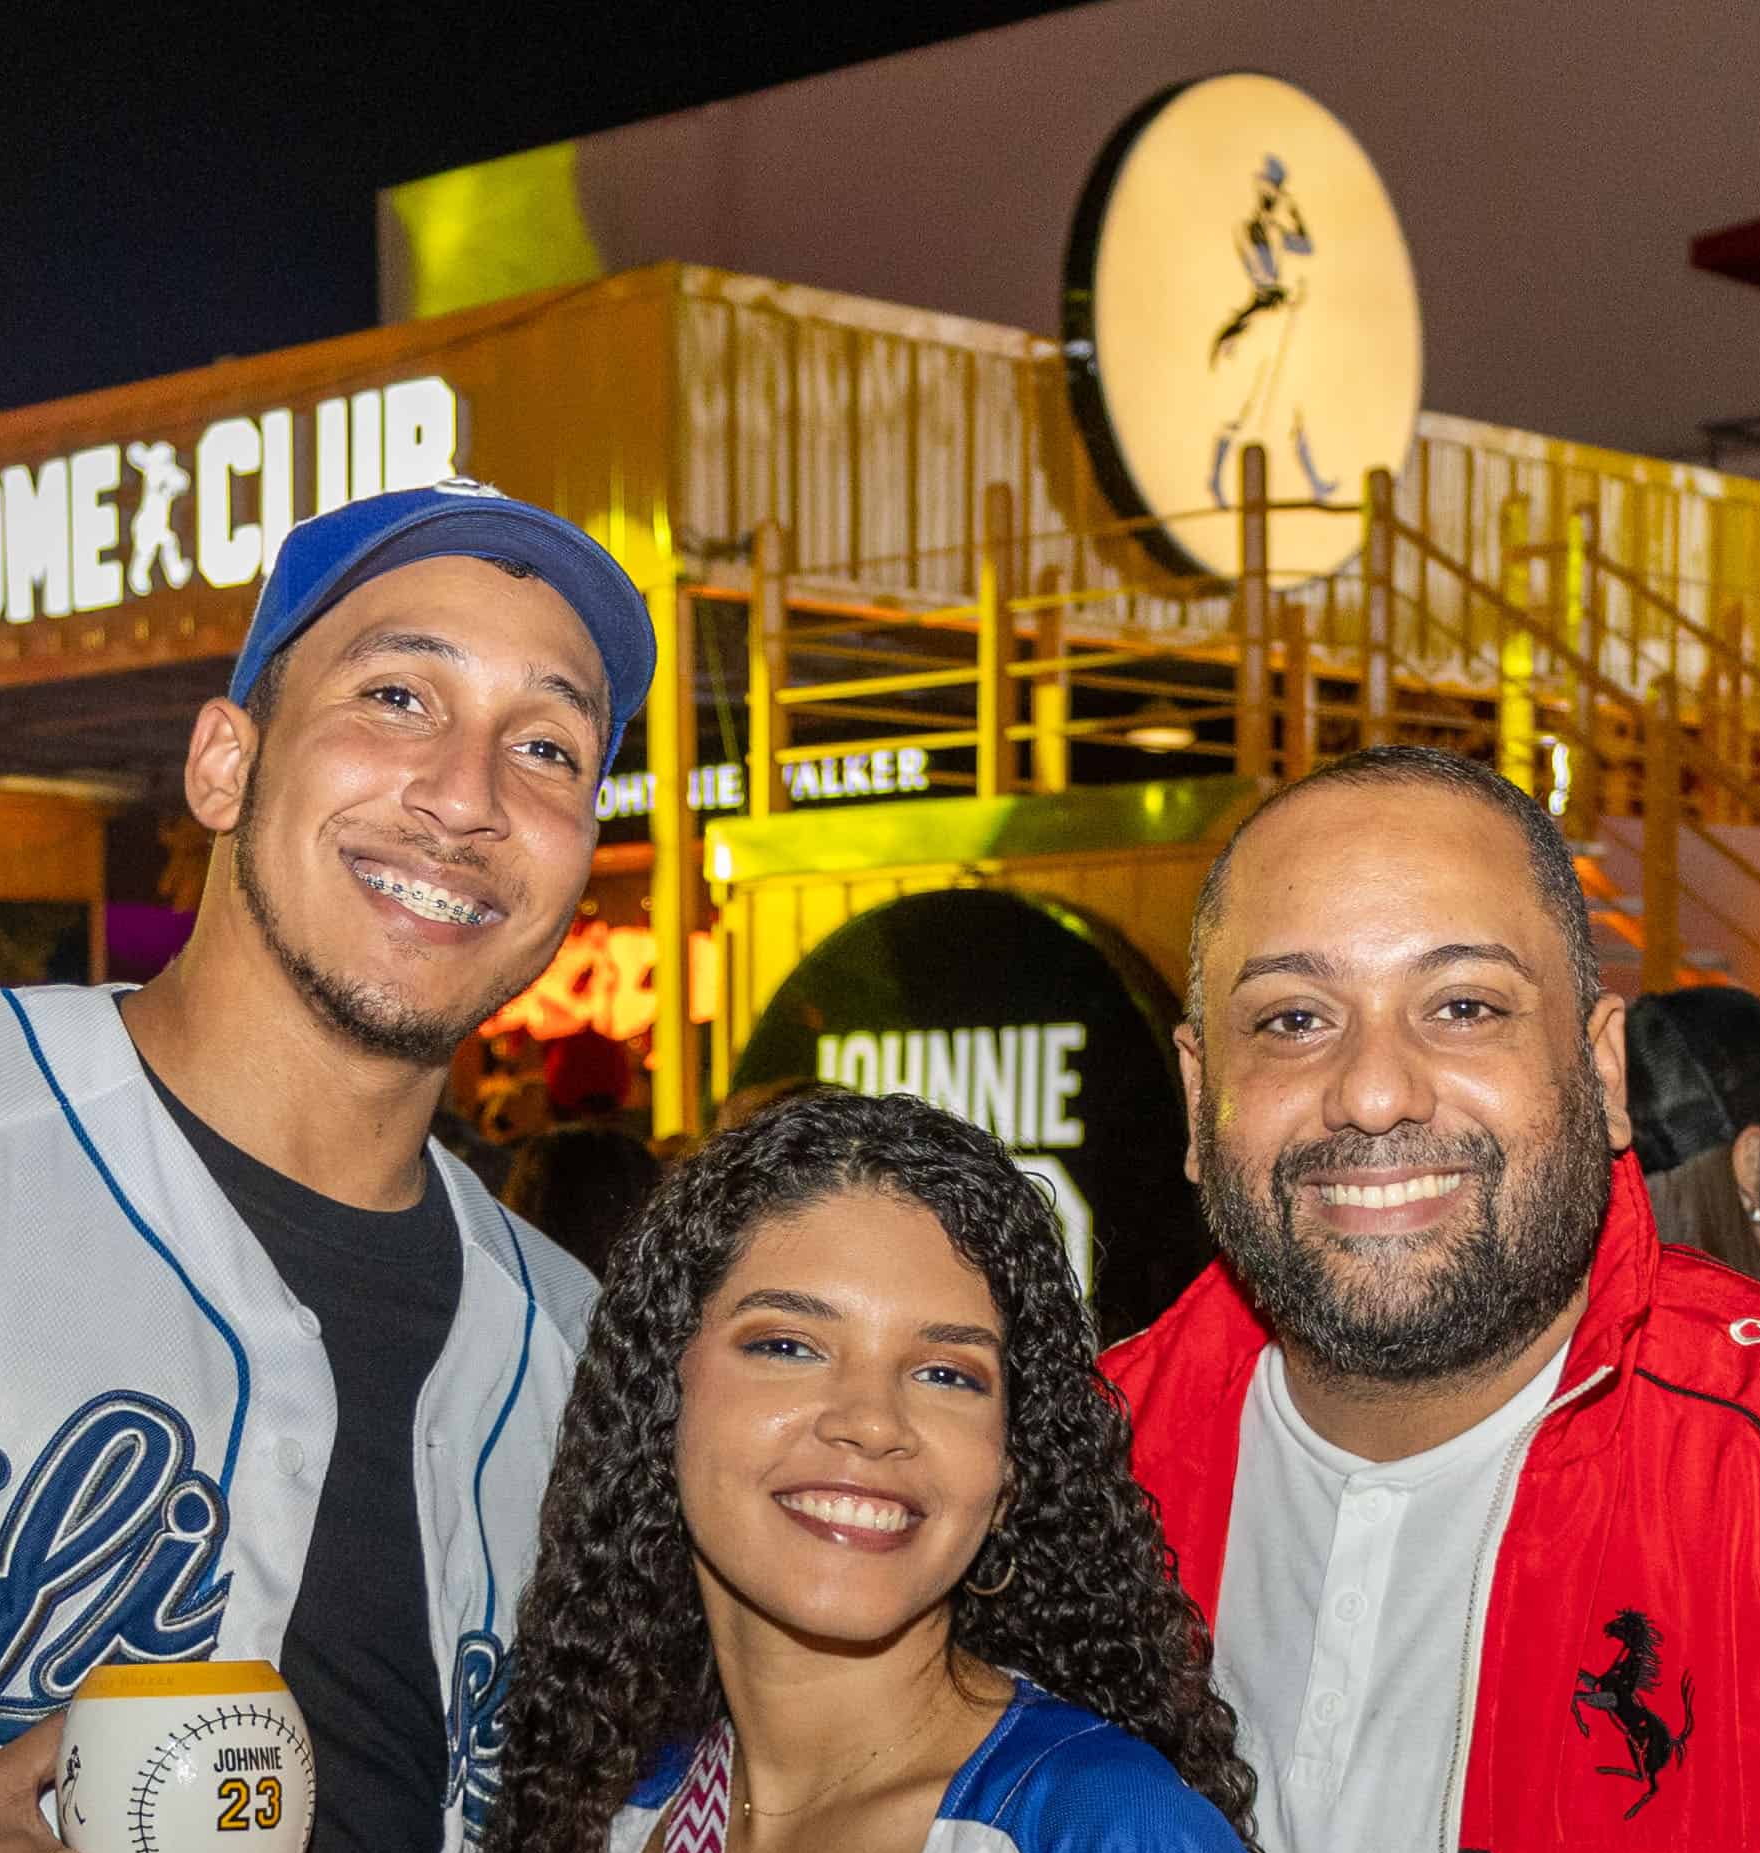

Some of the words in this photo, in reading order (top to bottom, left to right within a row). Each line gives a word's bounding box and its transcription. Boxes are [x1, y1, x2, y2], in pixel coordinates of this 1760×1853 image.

[195, 374, 458, 589] CLUB
[782, 747, 930, 801] ALKER
[214, 1746, 283, 1774] JOHNNIE
[217, 1776, 282, 1832] 23
